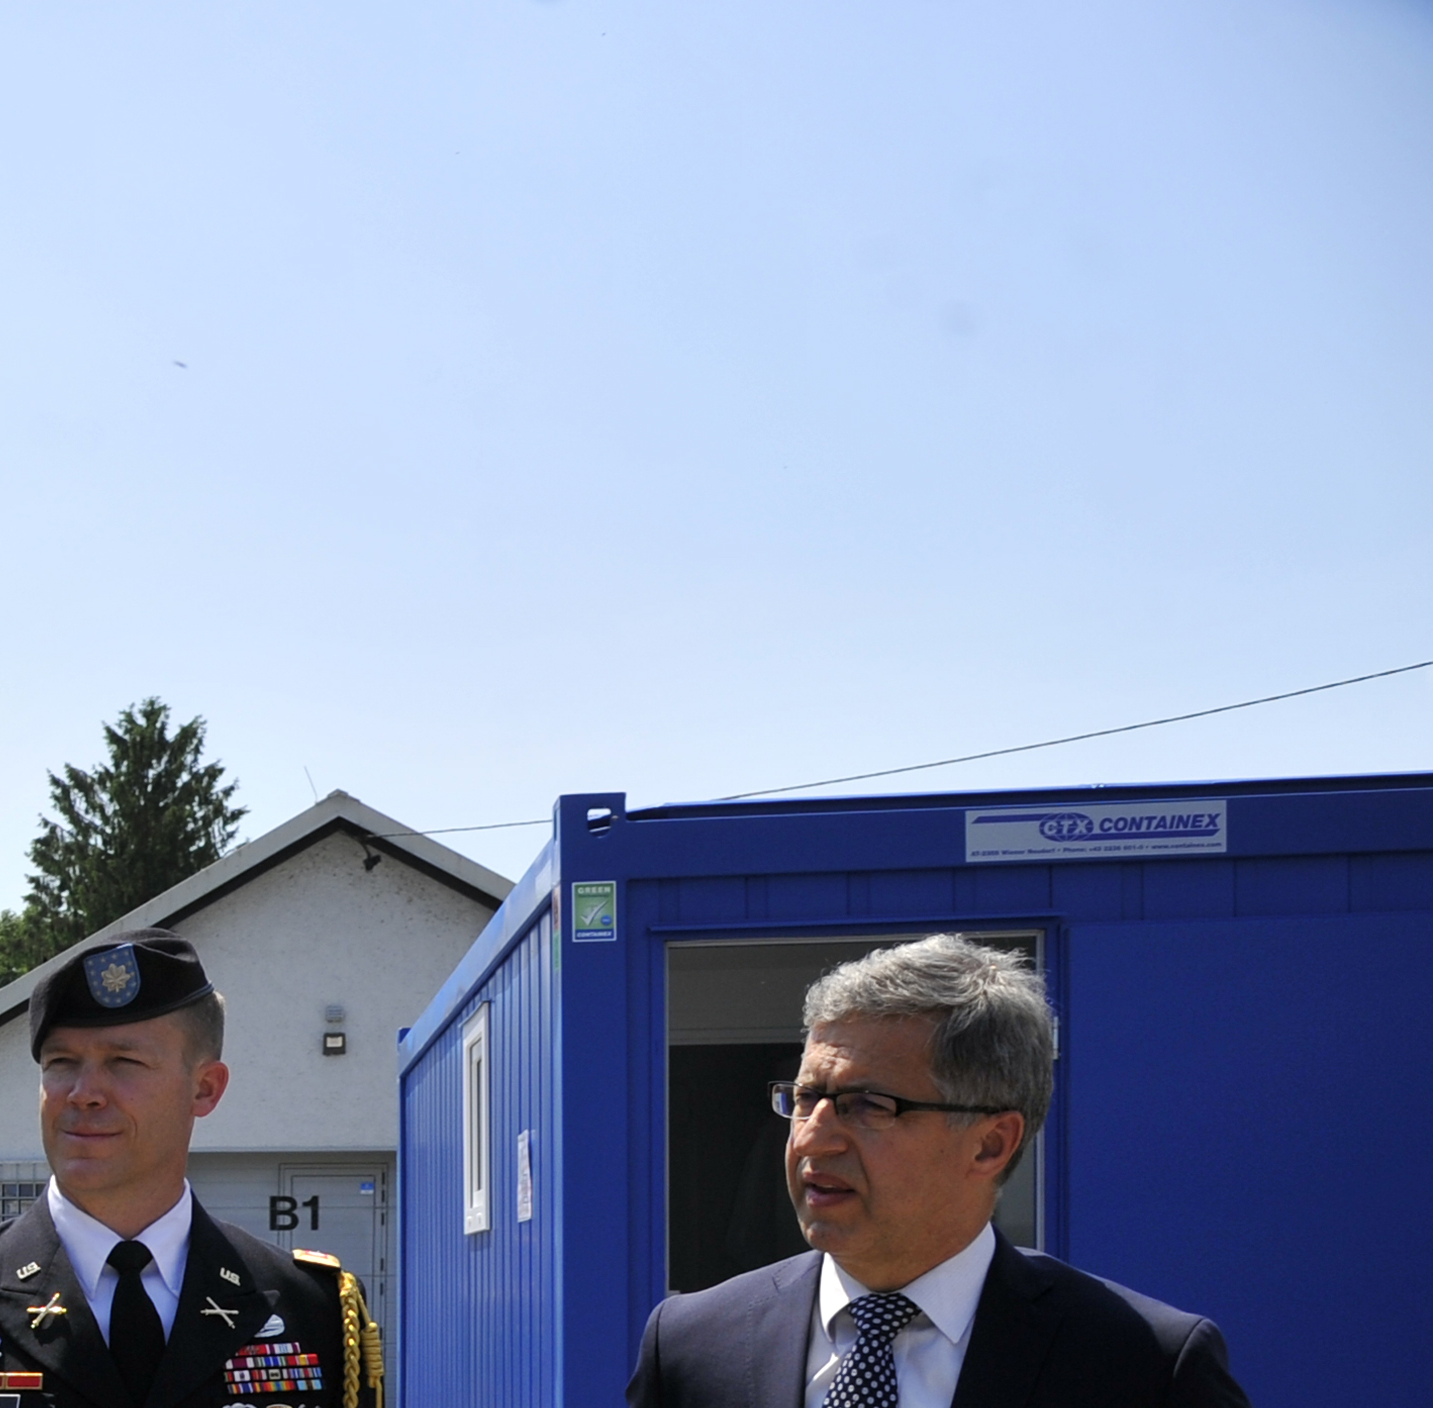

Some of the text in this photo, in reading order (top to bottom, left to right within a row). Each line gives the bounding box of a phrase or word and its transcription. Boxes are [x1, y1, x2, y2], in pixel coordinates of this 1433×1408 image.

[1042, 813, 1221, 835] CTX CONTAINEX
[577, 886, 611, 894] GREEN
[269, 1195, 319, 1231] B1
